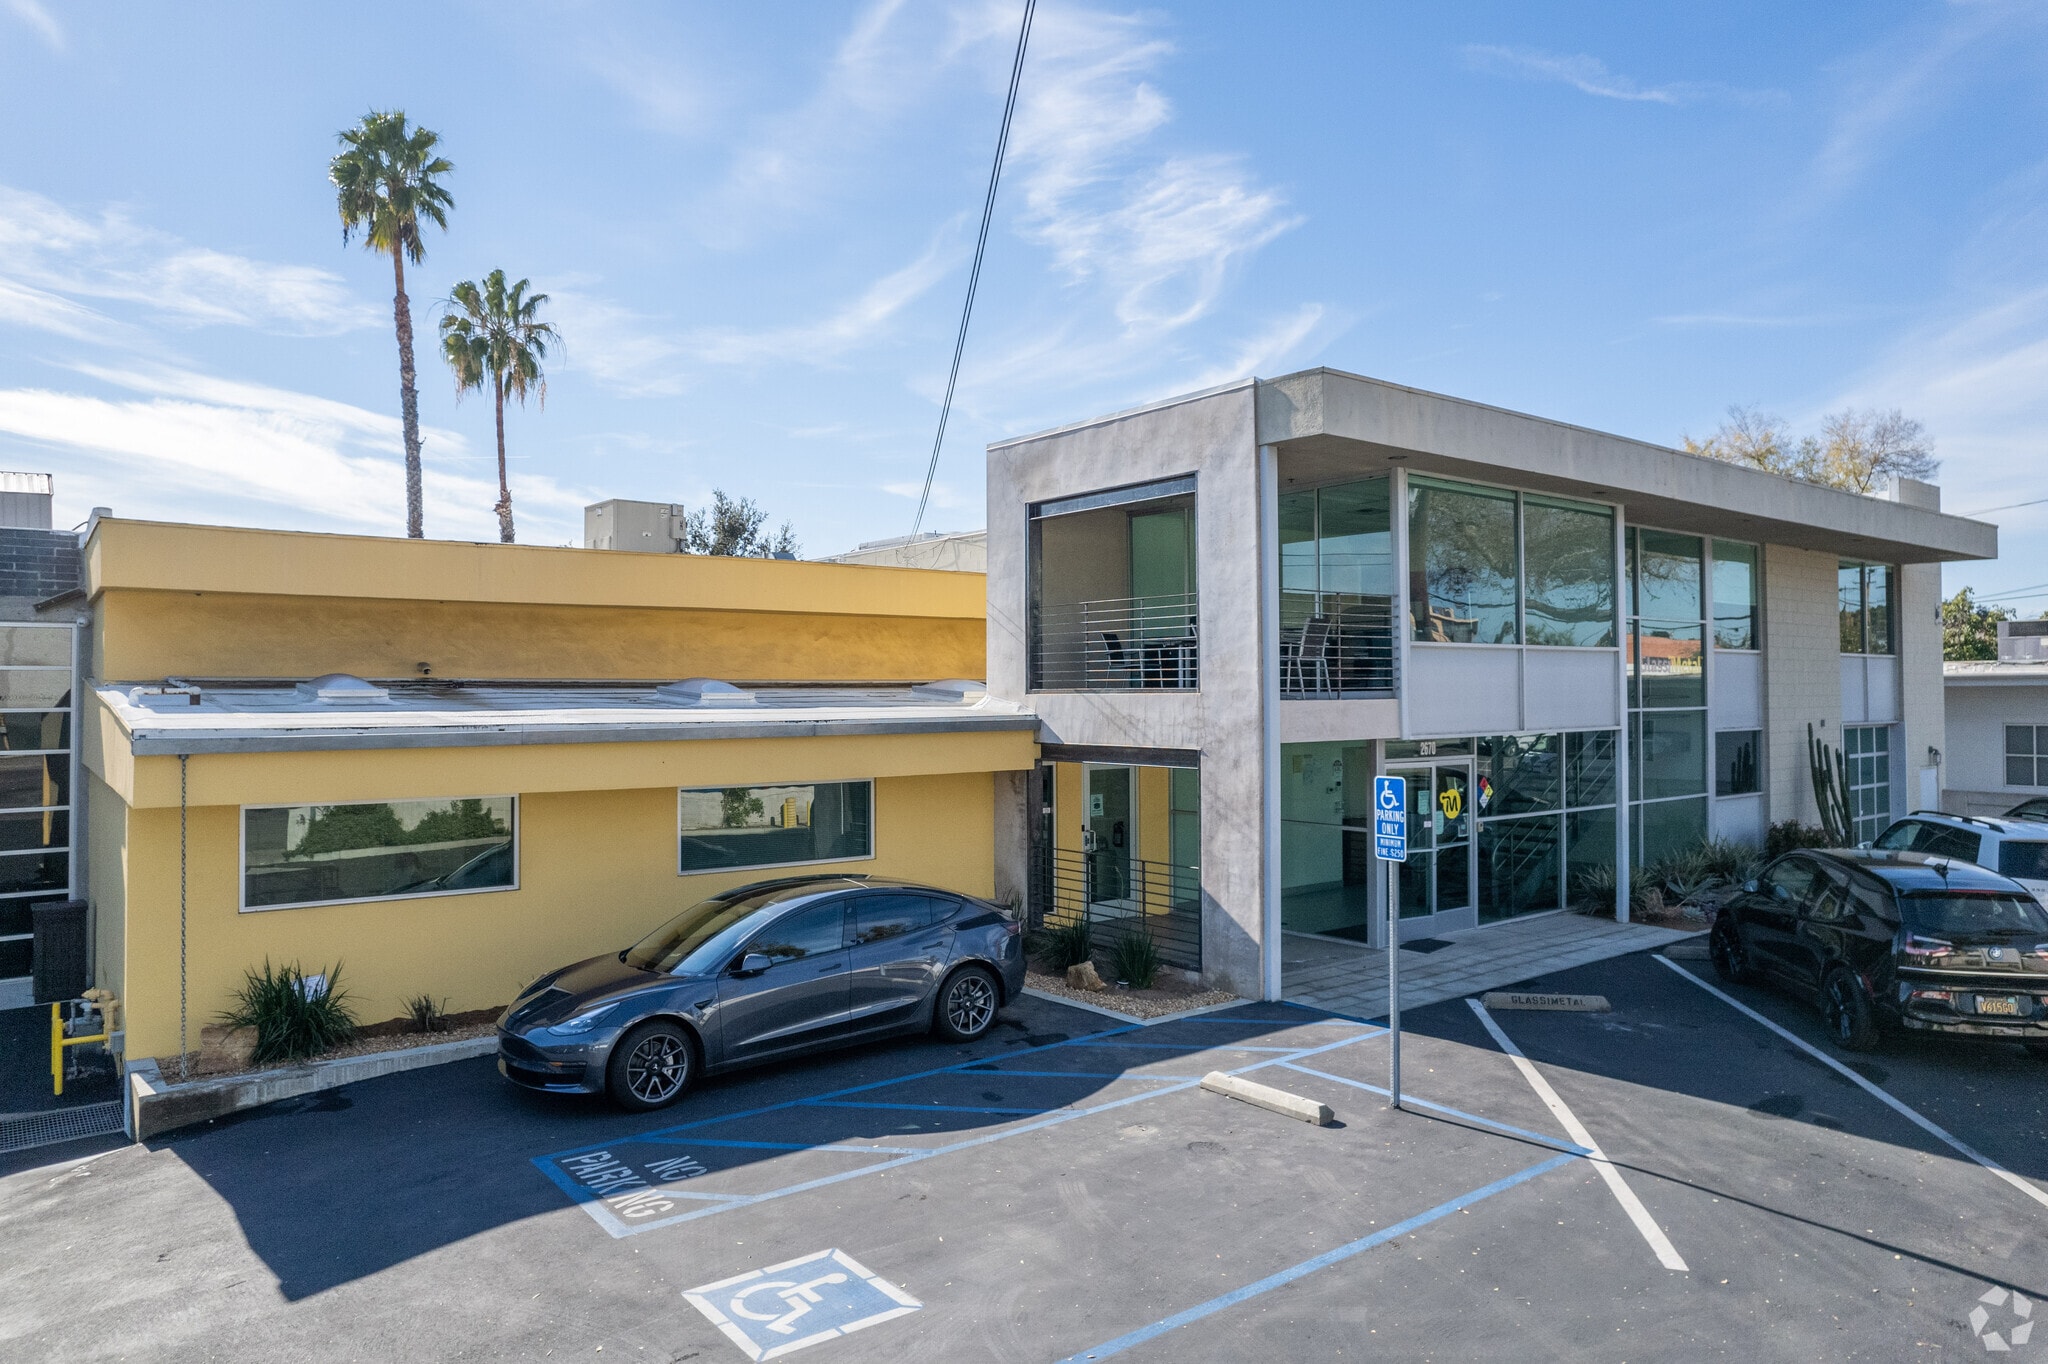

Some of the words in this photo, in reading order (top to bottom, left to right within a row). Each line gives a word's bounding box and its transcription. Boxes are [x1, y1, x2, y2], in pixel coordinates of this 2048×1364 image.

[1420, 741, 1436, 755] 2670
[1376, 809, 1405, 823] PARKING
[1381, 822, 1399, 835] ONLY
[1380, 838, 1401, 847] MINIMUM
[1377, 847, 1389, 856] FINE
[644, 1155, 708, 1181] NO
[560, 1150, 674, 1218] PARKING
